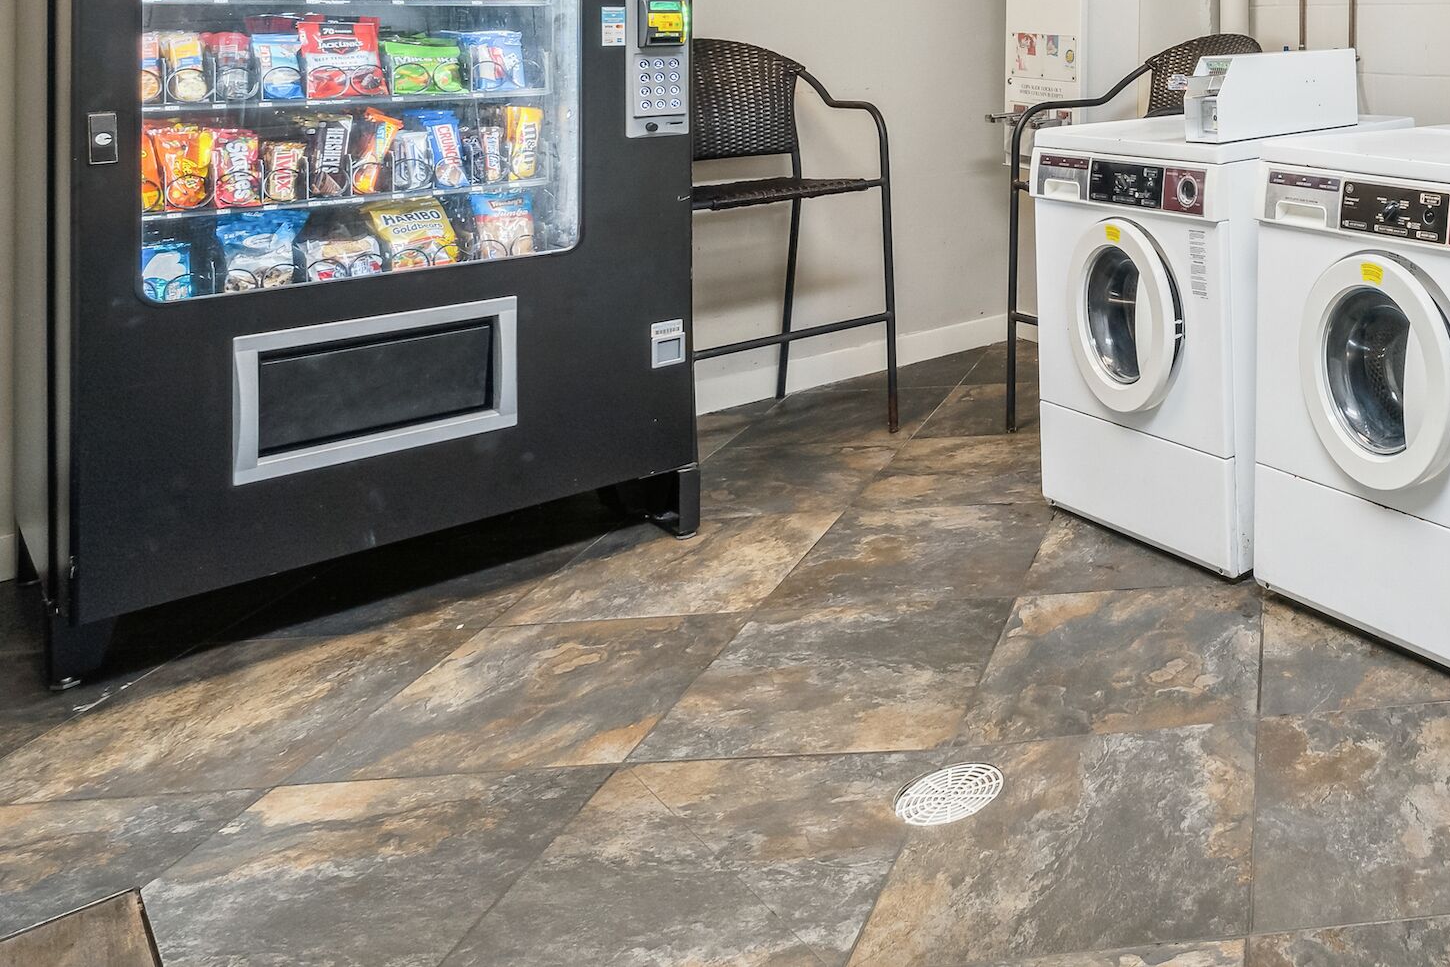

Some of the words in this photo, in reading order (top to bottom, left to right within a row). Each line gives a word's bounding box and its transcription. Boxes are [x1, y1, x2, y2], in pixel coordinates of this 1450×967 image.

[437, 125, 461, 168] CRUNCH
[382, 210, 441, 226] HARIBO
[392, 222, 443, 235] Goldbears
